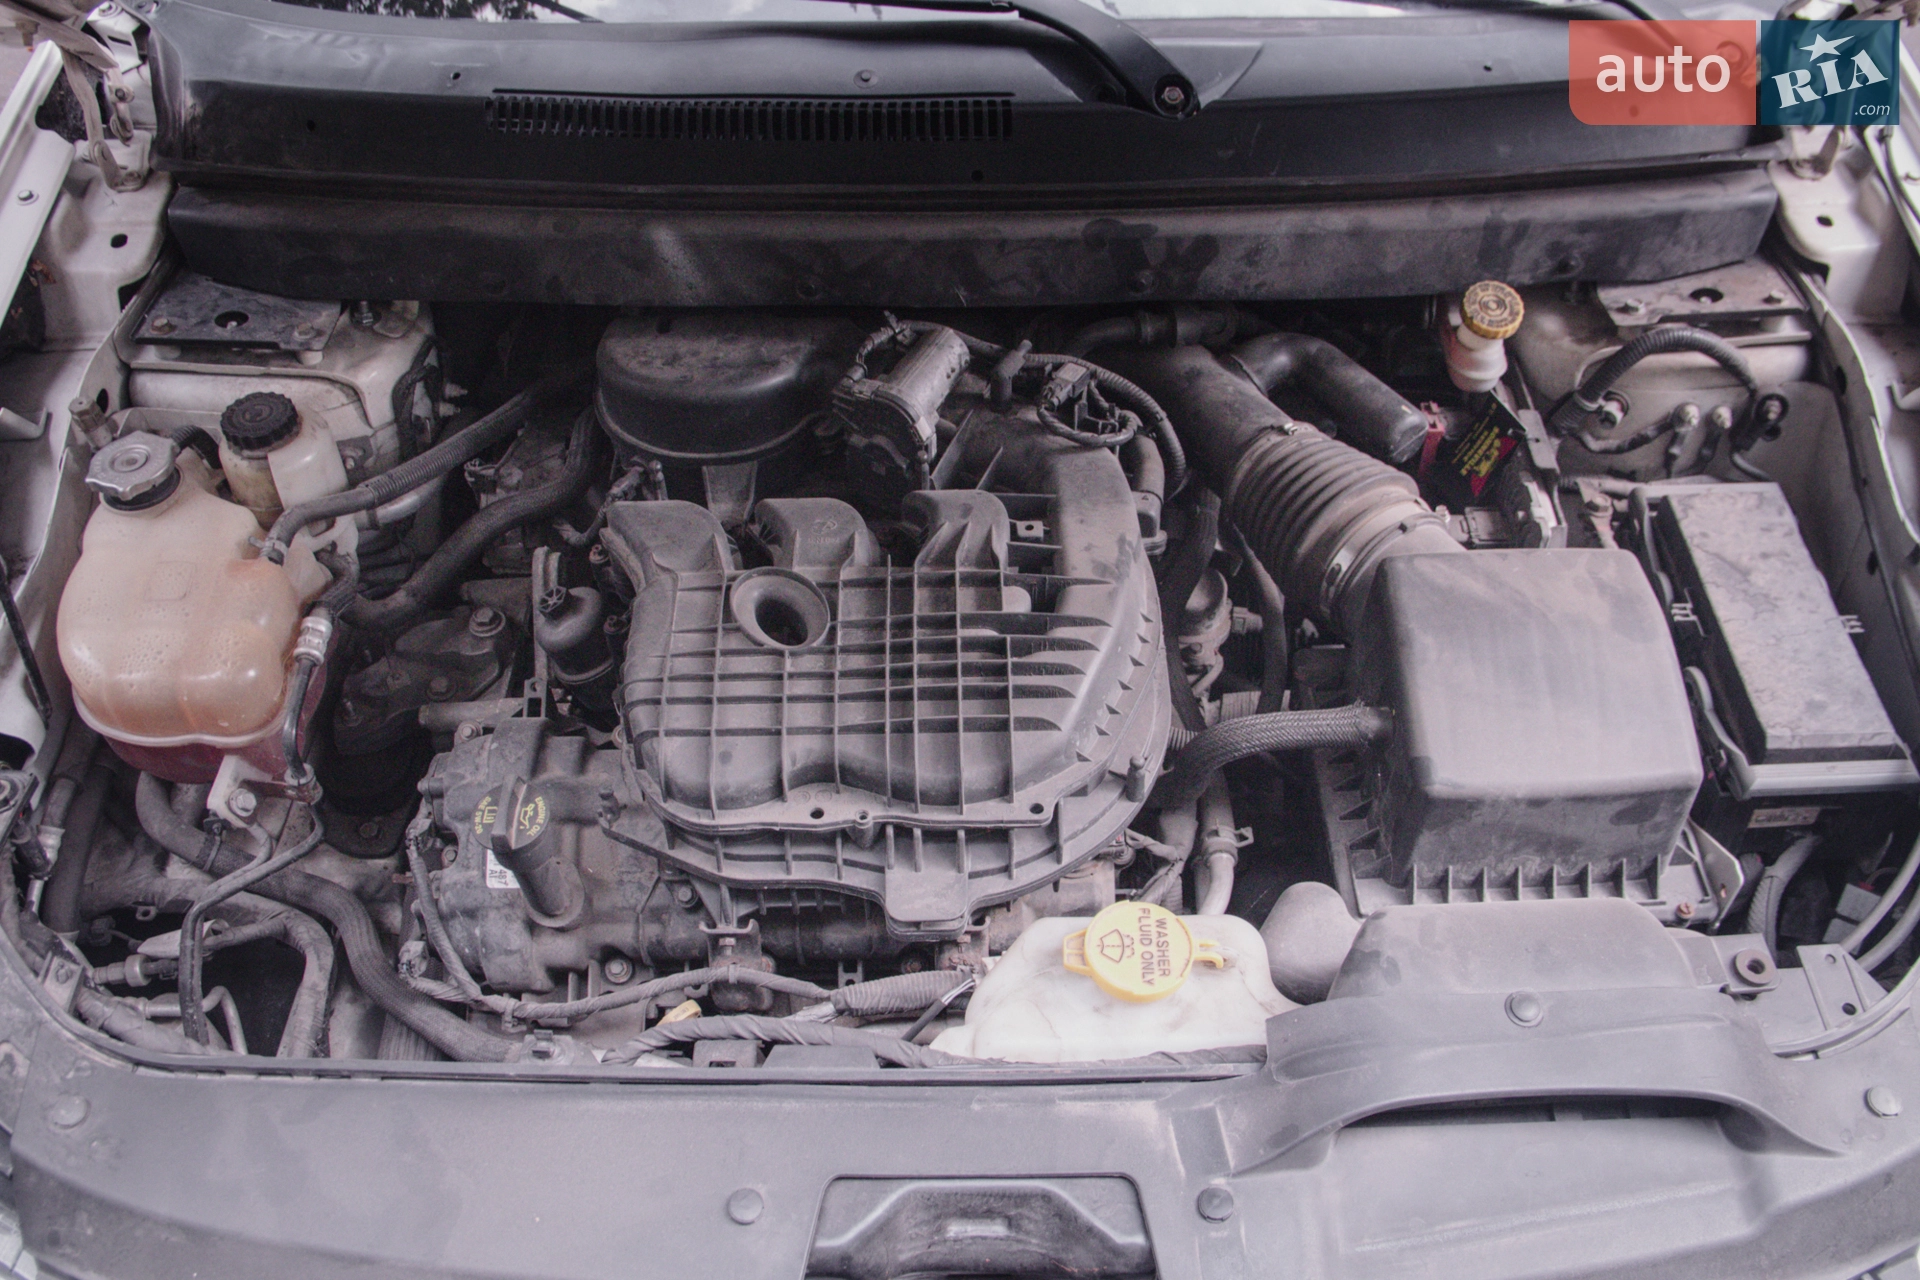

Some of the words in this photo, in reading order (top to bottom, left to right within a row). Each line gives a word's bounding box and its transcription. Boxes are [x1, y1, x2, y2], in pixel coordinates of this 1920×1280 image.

[477, 796, 492, 811] SAE
[534, 796, 547, 824] ENGINE
[474, 811, 484, 835] 5W-20
[526, 824, 541, 837] OIL
[1138, 907, 1153, 947] FLUID
[1155, 917, 1171, 978] WASHER
[1140, 951, 1156, 987] ONLY
